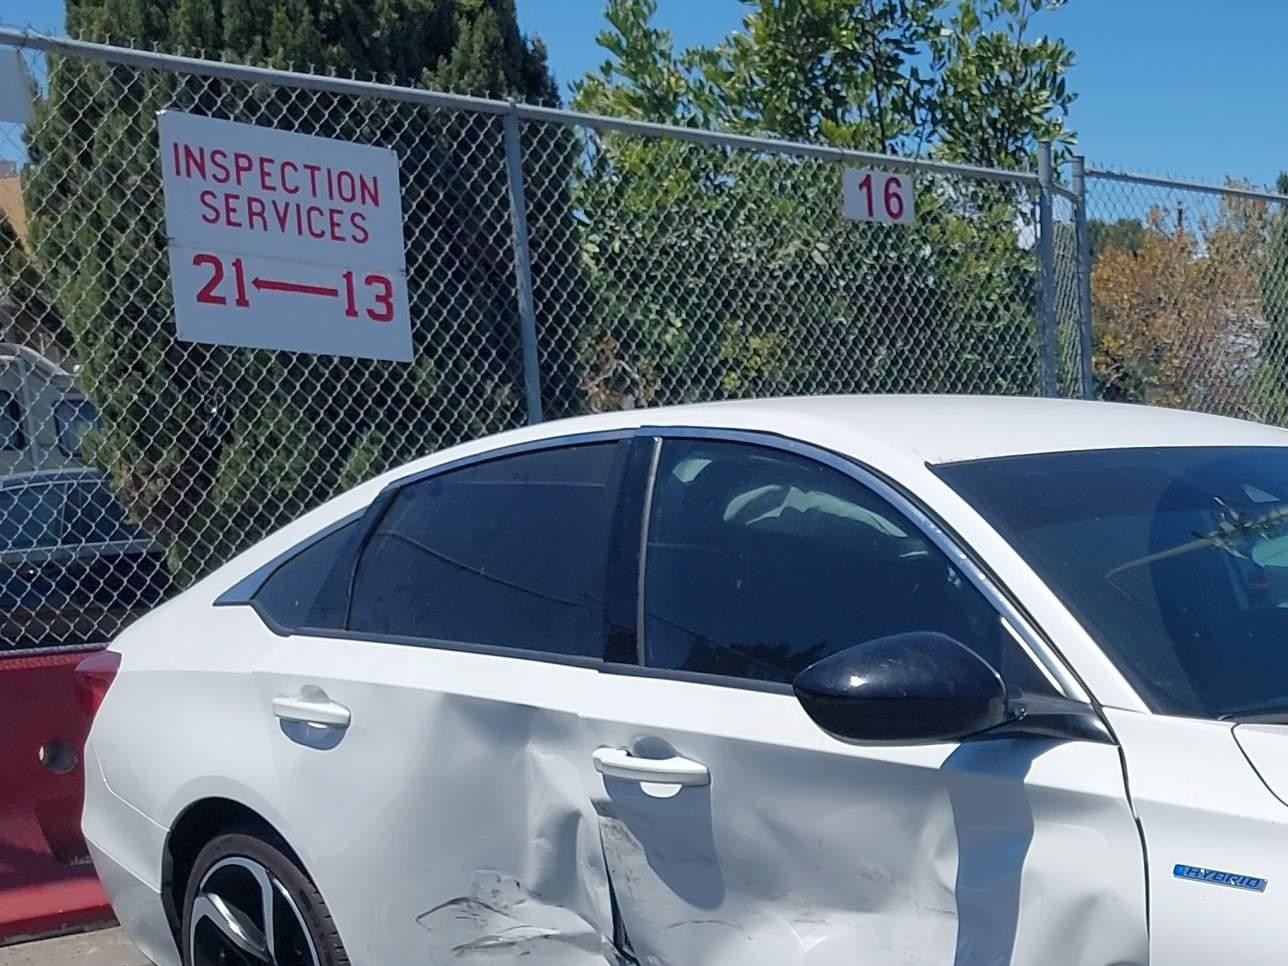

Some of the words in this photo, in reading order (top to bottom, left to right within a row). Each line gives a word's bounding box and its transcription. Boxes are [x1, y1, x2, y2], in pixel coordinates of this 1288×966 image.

[173, 142, 380, 207] INSPECTION
[858, 173, 904, 220] 16
[200, 190, 371, 244] SERVICES
[193, 253, 250, 308] 21
[343, 271, 394, 322] 13
[1185, 866, 1260, 888] HYBRID
